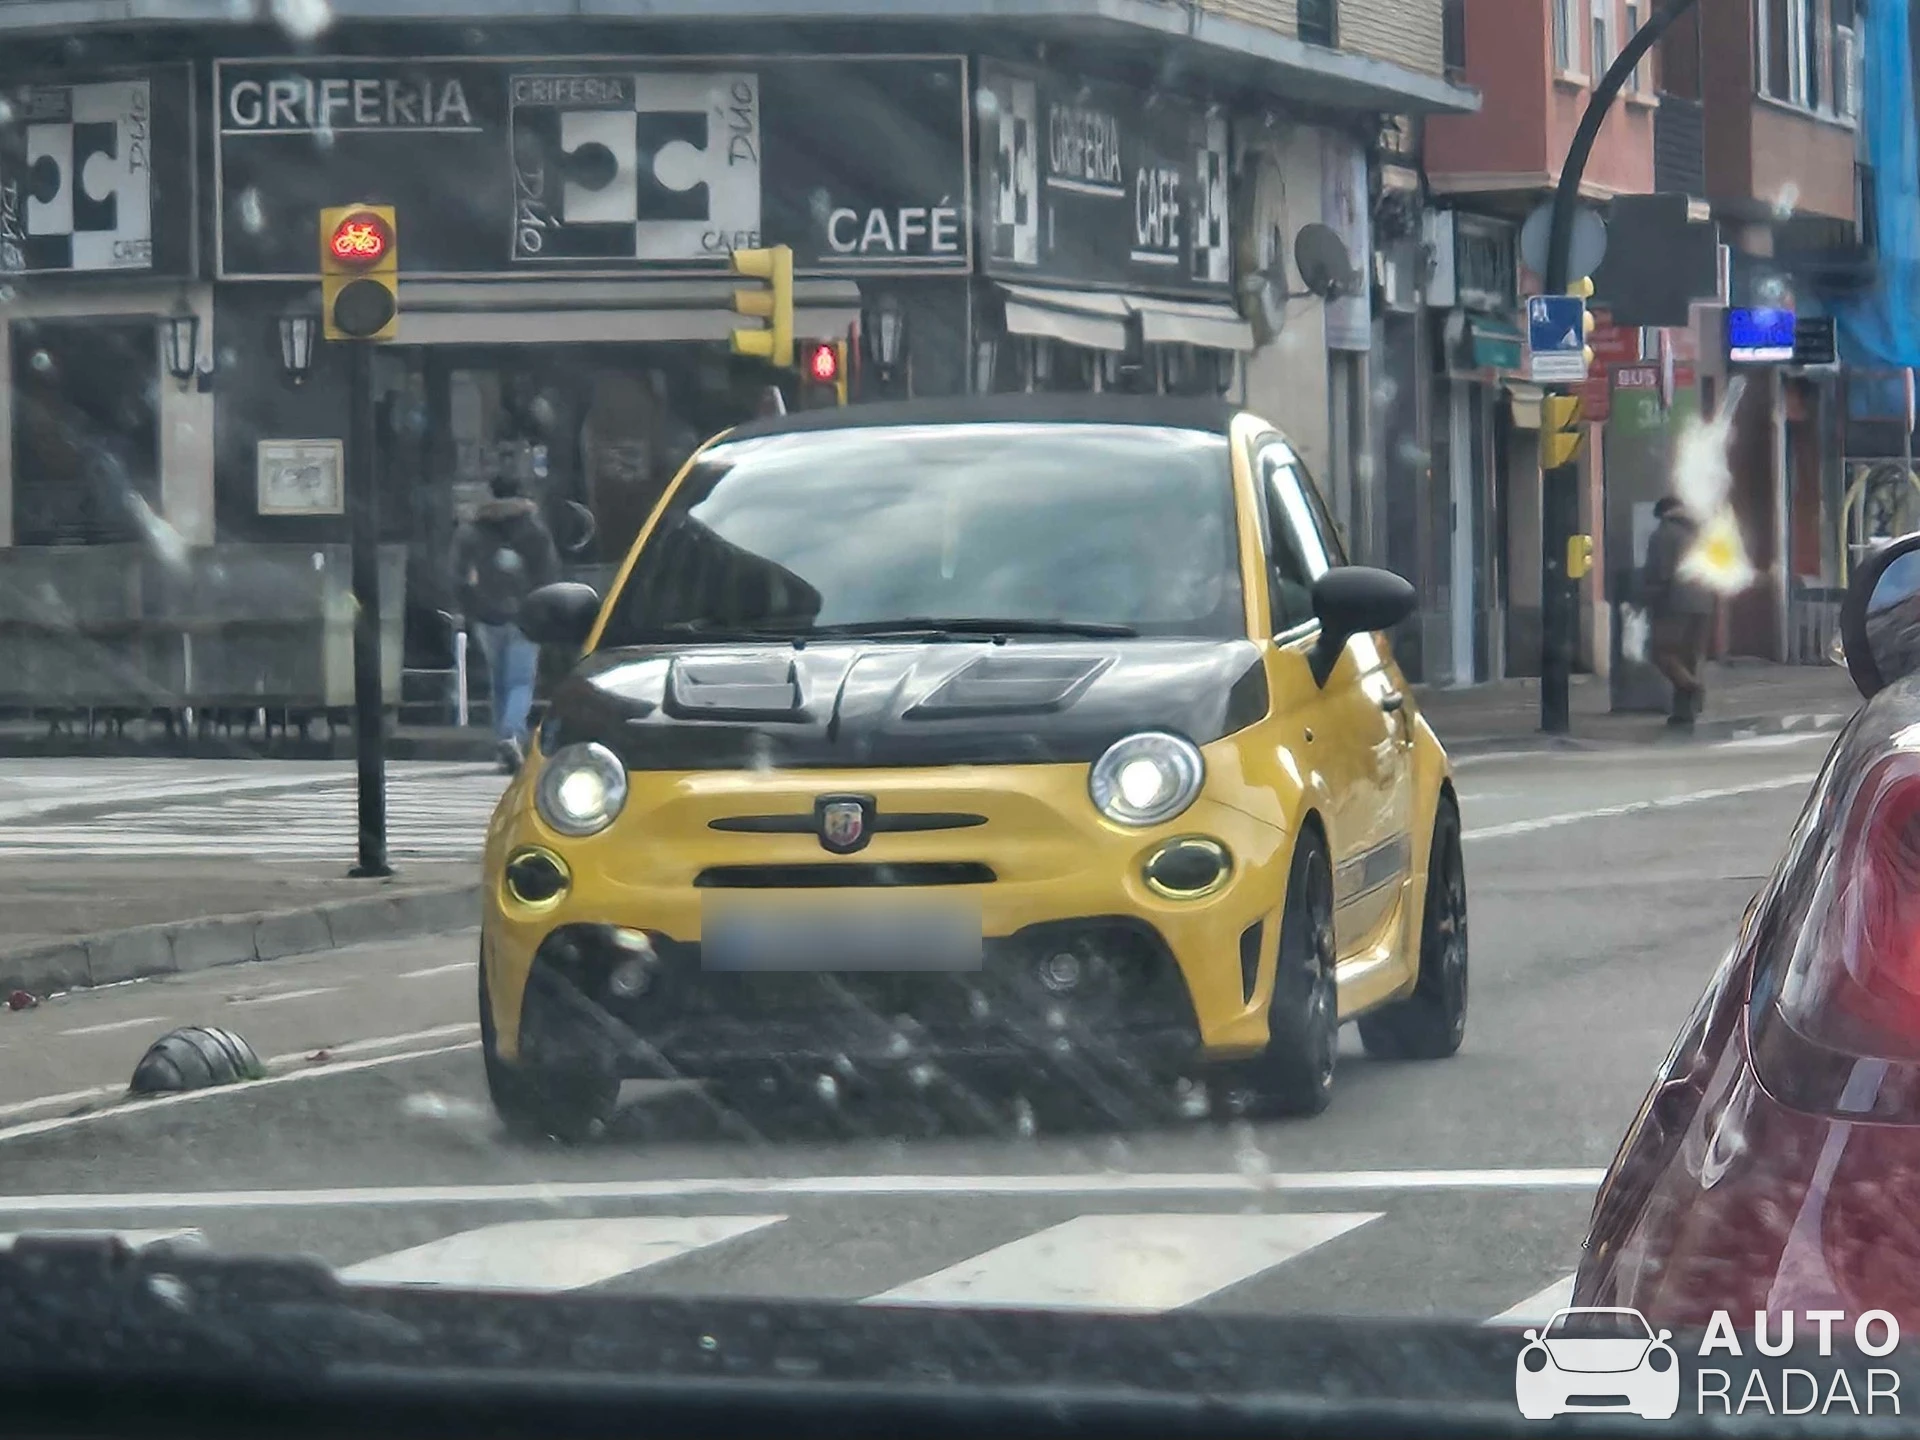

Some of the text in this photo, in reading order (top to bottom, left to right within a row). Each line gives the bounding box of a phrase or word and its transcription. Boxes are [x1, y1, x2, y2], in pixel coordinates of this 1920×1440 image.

[229, 78, 472, 126] GRIFERIA
[515, 76, 625, 101] GRIFERIA
[827, 196, 958, 253] CAFÉ
